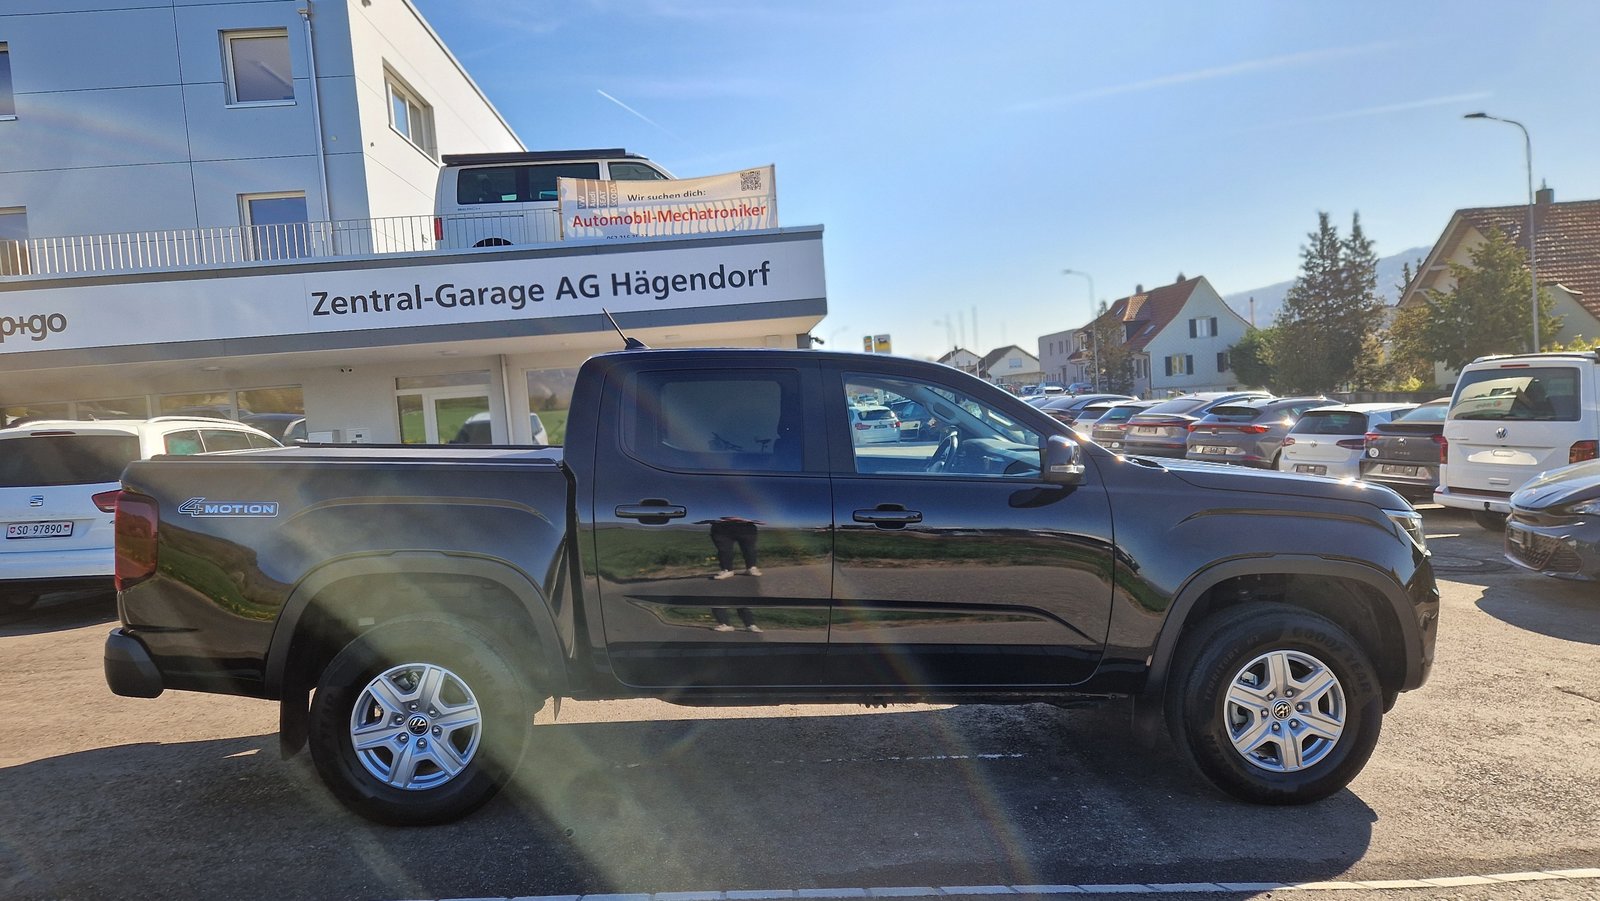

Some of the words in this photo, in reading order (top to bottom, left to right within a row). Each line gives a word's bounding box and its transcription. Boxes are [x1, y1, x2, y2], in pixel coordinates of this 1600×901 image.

[599, 190, 607, 207] SEAT
[627, 194, 644, 202] Wir
[647, 192, 681, 201] suchen
[683, 189, 706, 198] dich:
[572, 204, 767, 228] Automobil-Mechatroniker
[311, 283, 545, 316] Zentral-Garage
[555, 274, 600, 300] AG
[611, 261, 770, 300] Hägendorf
